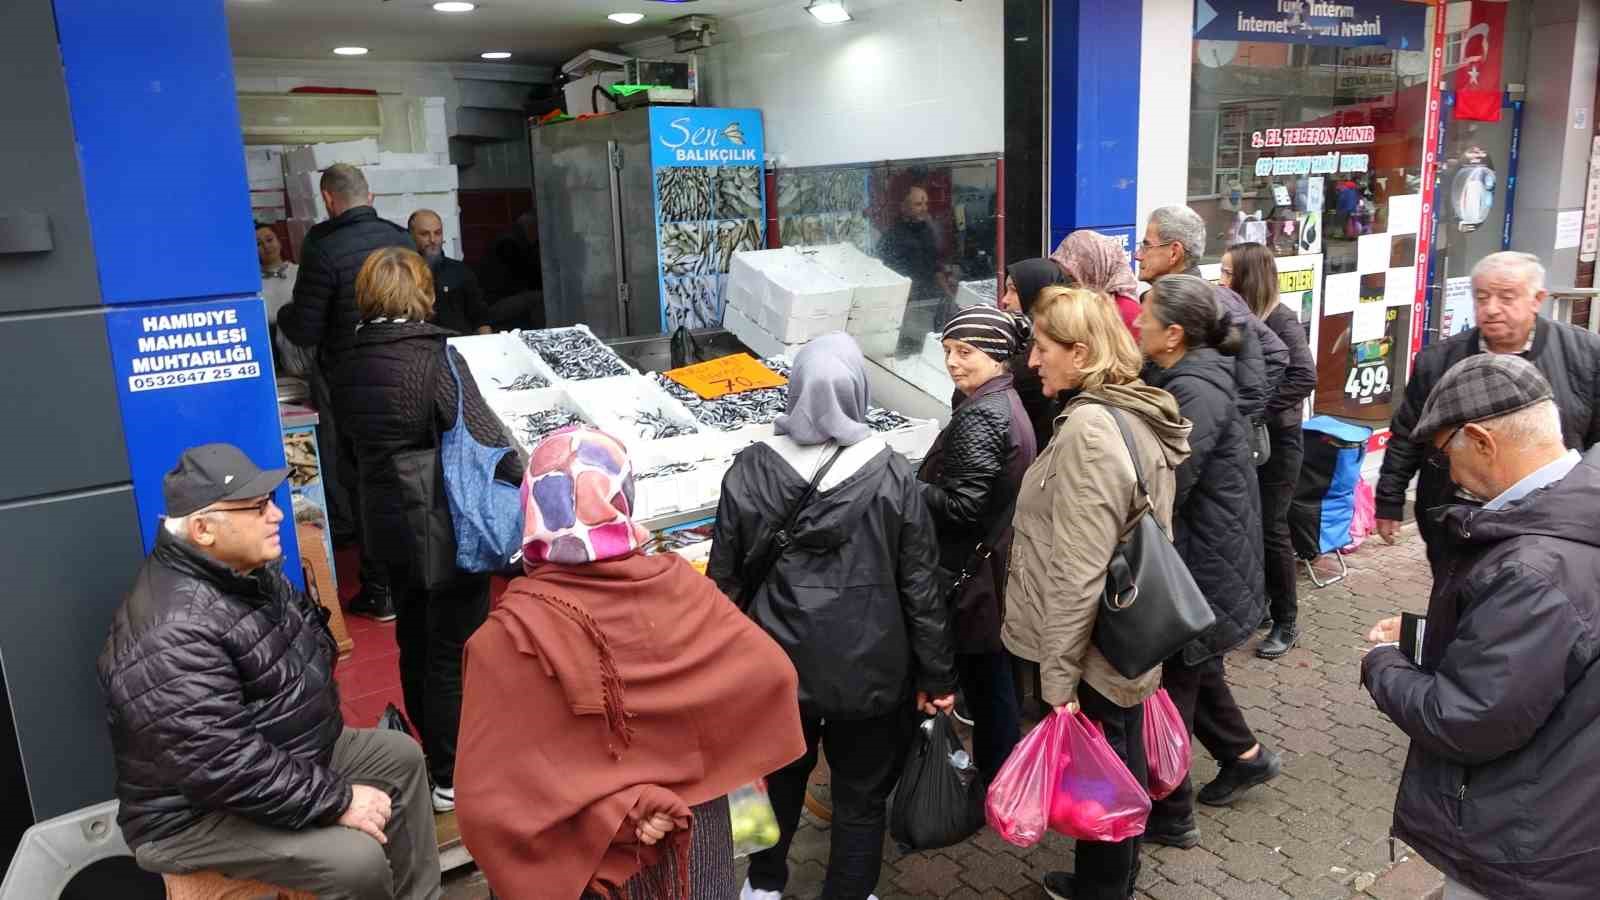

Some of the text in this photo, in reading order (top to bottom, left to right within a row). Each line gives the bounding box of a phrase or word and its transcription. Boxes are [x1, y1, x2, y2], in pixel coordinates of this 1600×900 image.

[1265, 128, 1282, 147] EL
[1283, 126, 1337, 146] TELEFON
[1335, 125, 1375, 144] ALINIR
[676, 148, 757, 164] BALIKÇILIK
[132, 345, 252, 373] MUHTARLIĞI
[134, 365, 257, 389] 0532647 25 48
[709, 376, 753, 392] 70
